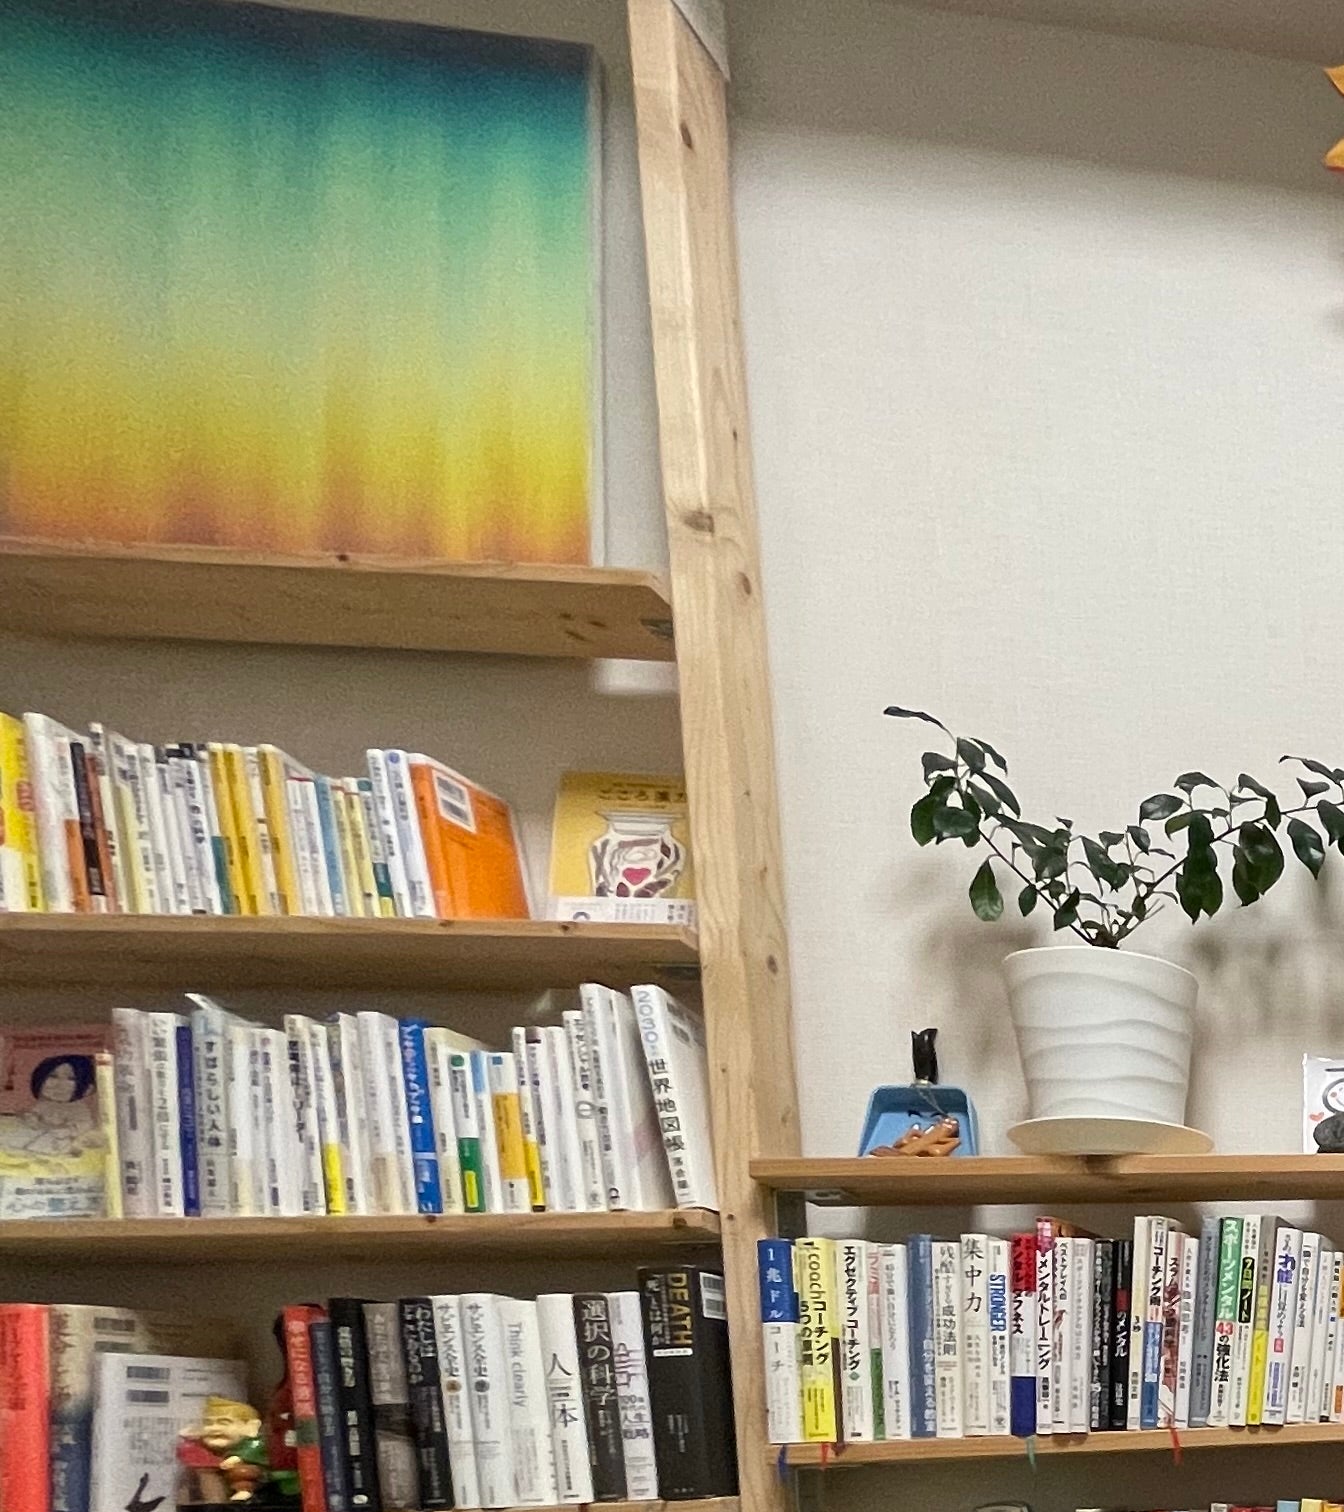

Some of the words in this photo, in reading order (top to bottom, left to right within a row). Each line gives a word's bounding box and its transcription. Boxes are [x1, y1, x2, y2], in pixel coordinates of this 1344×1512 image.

[667, 1272, 694, 1346] DEATH
[963, 1237, 984, 1313] 集中力
[507, 1321, 523, 1358] Think
[814, 1300, 829, 1366] コーチング
[1037, 1258, 1052, 1371] メンタルトレーニング
[512, 1359, 530, 1408] clearly
[581, 1299, 617, 1406] 選択の科学
